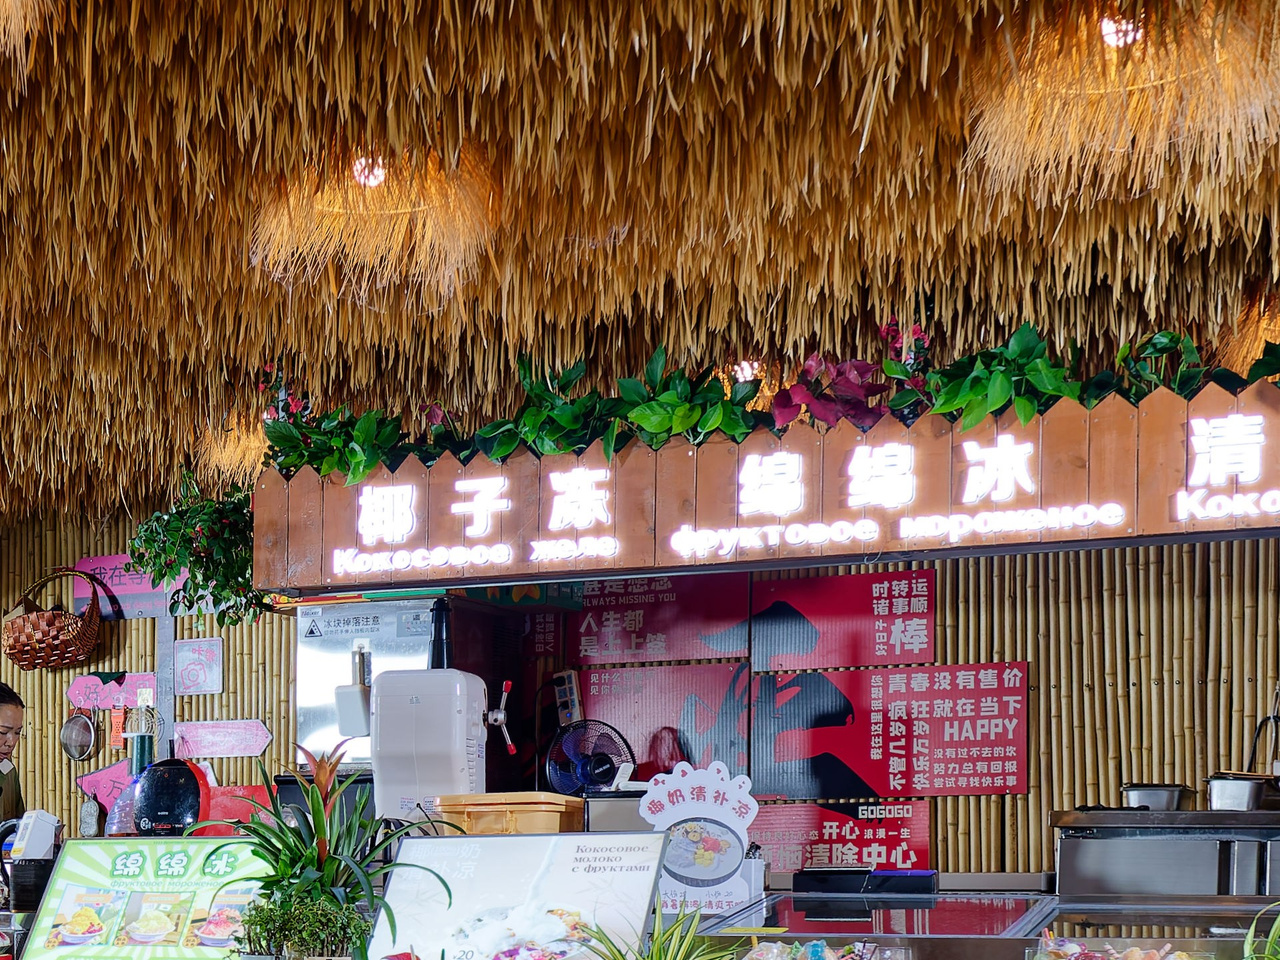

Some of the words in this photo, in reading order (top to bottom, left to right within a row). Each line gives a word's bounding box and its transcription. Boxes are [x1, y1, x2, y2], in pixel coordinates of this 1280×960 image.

[1188, 413, 1266, 487] 清
[738, 433, 1034, 517] 绵绵冰
[357, 467, 611, 546] 椰子冻
[670, 516, 880, 557] фруктовое
[332, 542, 514, 576] Кокосовое
[529, 535, 620, 562] желе
[619, 594, 655, 605] MISSING
[659, 592, 676, 602] YOU
[872, 579, 928, 598] 时转运
[872, 597, 928, 615] 诸事顺
[579, 609, 644, 633] 人生都
[875, 619, 888, 656] 好日子
[889, 617, 929, 655] 棒
[888, 667, 1023, 694] 青春没有售价
[871, 675, 883, 760] 我在这里很想你
[888, 696, 1023, 720] 疯狂就在当下
[943, 718, 1019, 742] HAPPY
[889, 721, 907, 791] 不管几岁
[913, 720, 930, 791] 快乐万岁
[933, 746, 1017, 759] 没有过不去的坎
[933, 760, 1018, 775] 努力总有回报
[933, 775, 1017, 788] 尝试寻找快乐事
[647, 785, 752, 819] 椰奶清补凉
[858, 805, 913, 819] GOGOGO
[823, 821, 860, 840] 开心
[864, 828, 911, 839] 浪漫一生
[575, 844, 649, 854] Кокосовое
[113, 852, 235, 877] 绵绵冰
[582, 864, 651, 874] фруктами
